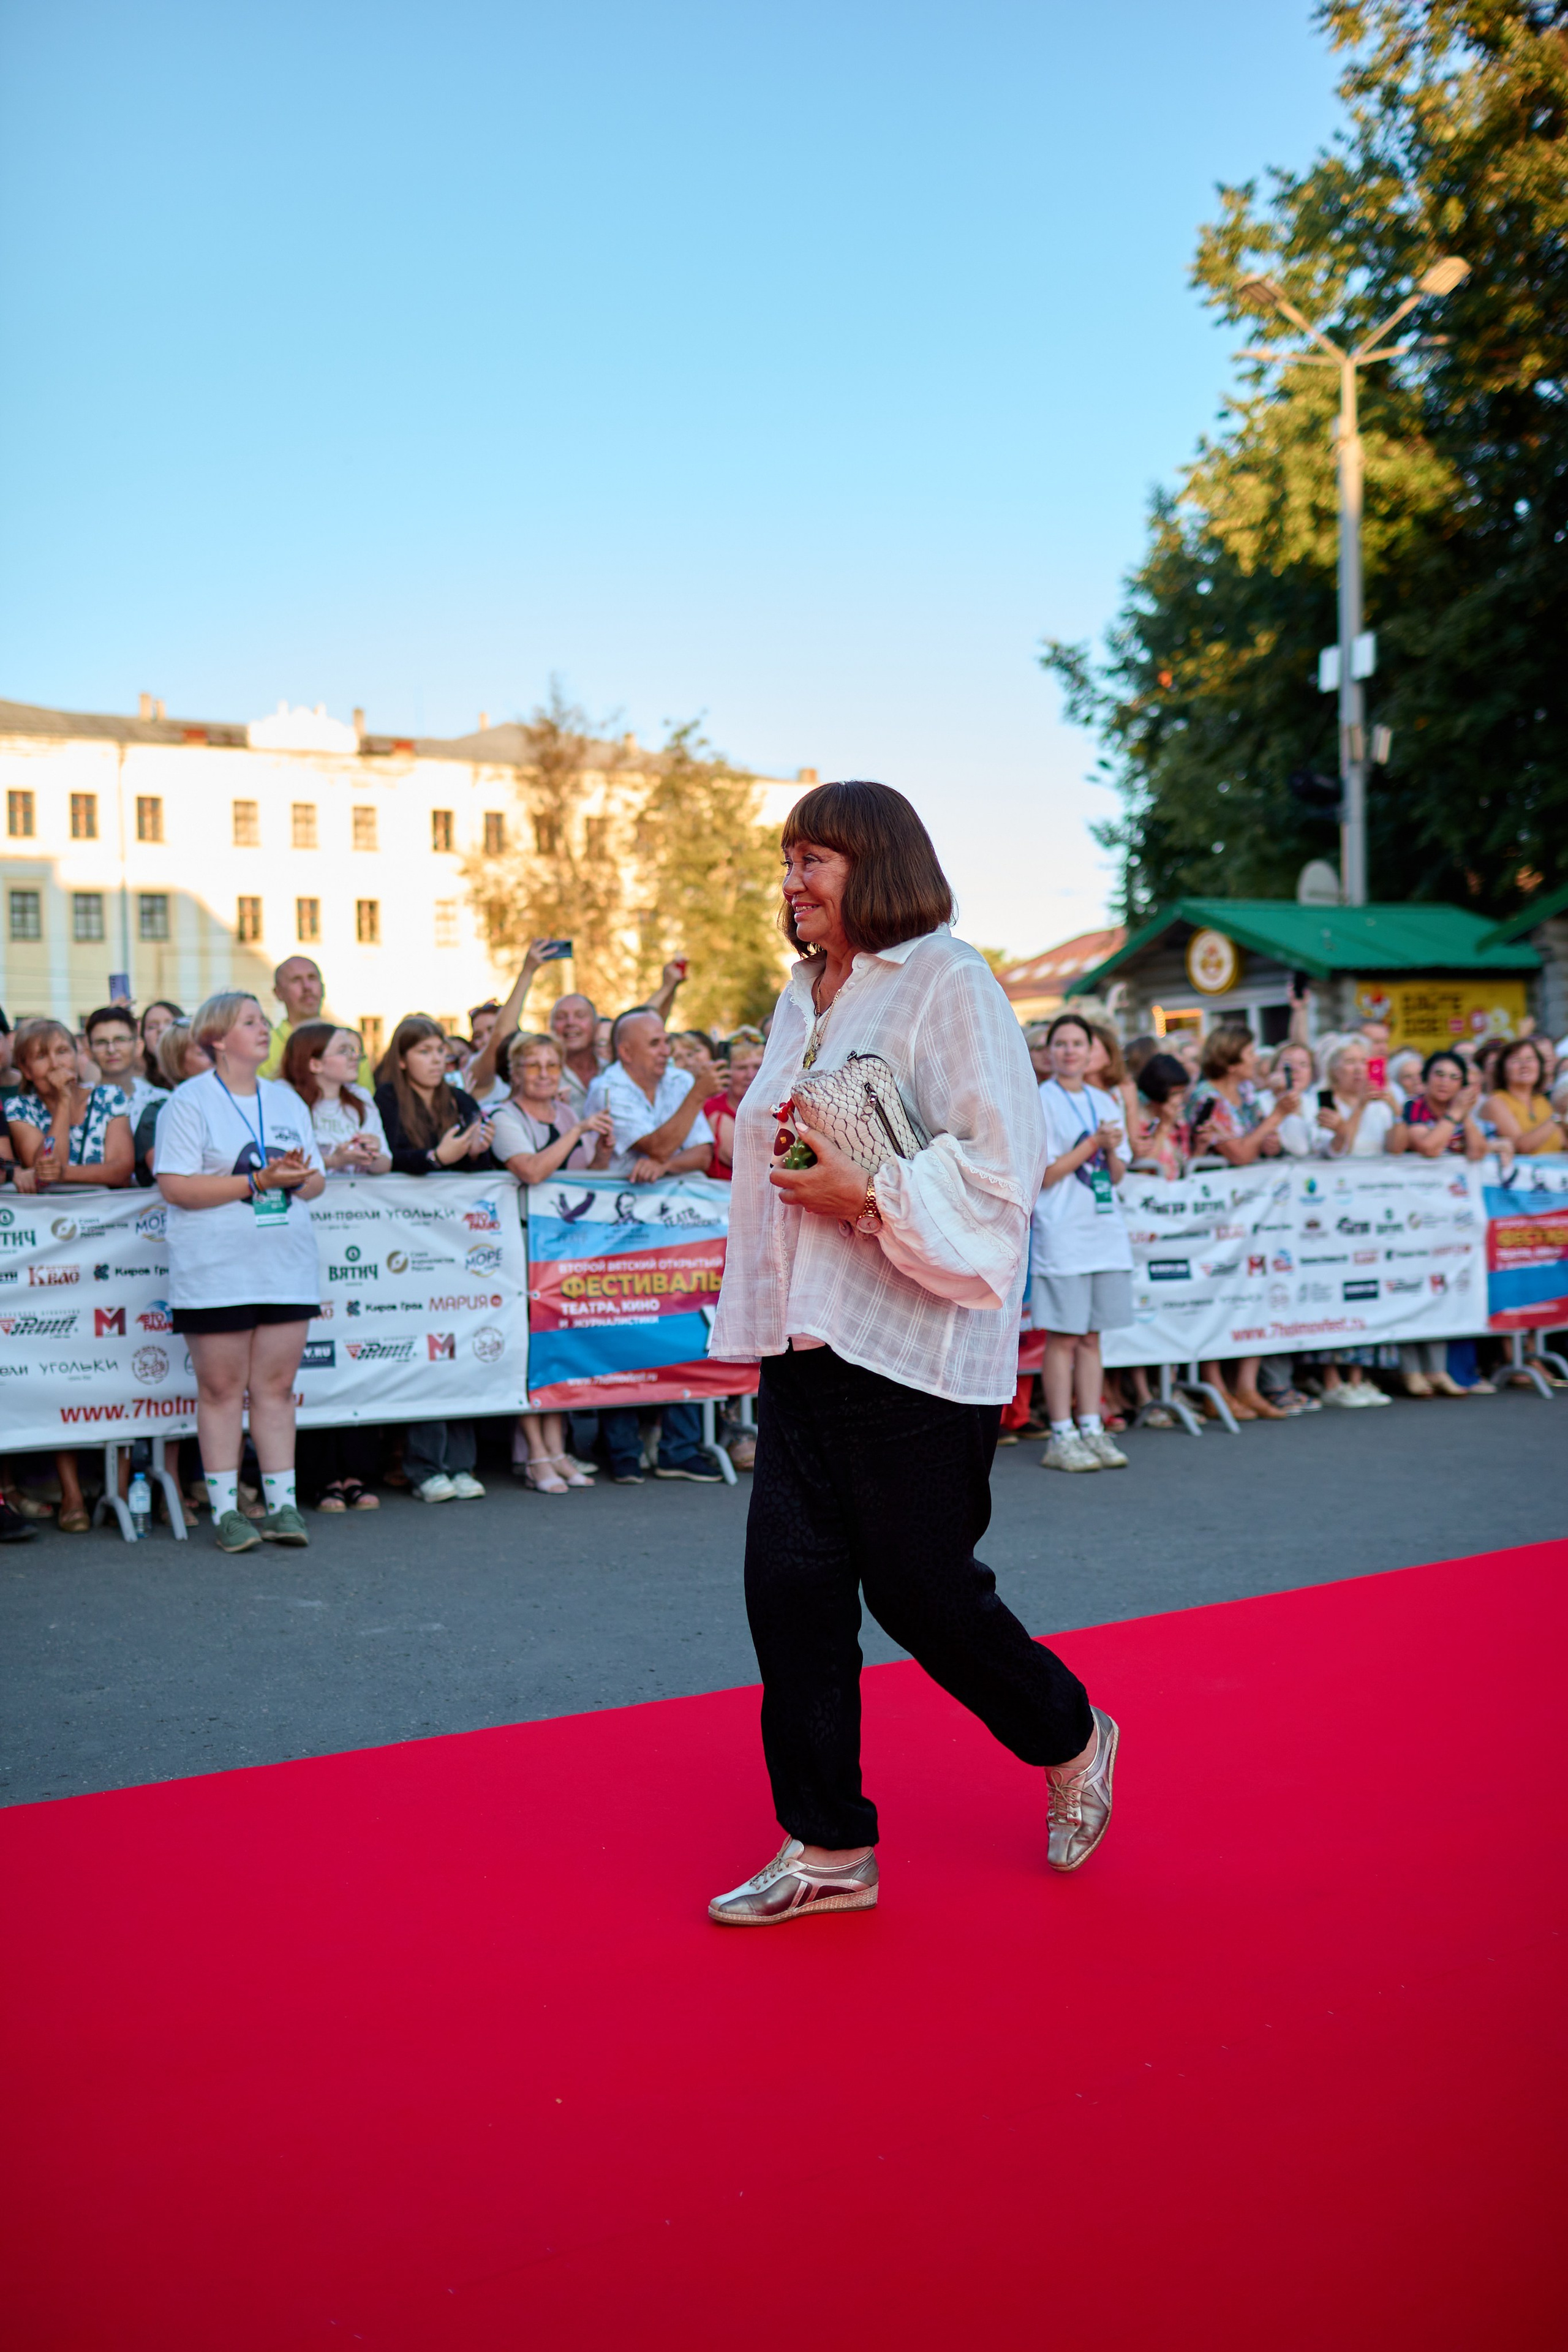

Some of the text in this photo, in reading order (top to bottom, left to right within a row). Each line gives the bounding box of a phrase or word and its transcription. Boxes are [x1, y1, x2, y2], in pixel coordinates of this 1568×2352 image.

[135, 1215, 167, 1234] МОР
[0, 1230, 37, 1247] ТИЧ
[465, 1247, 503, 1270] МОРЕ
[558, 1261, 605, 1274] ВТОРОЙ
[607, 1259, 657, 1272] ВЯТСКИЙ
[116, 1267, 150, 1278] Киров
[154, 1265, 169, 1277] Гр
[328, 1264, 378, 1282] ВЯТИЧ
[561, 1272, 723, 1299] ФЕСТИВАЛЬ
[366, 1304, 397, 1314] Киров
[401, 1302, 423, 1313] Град
[560, 1298, 660, 1315] ТЕАТРА, КИНО
[143, 1321, 173, 1332] РАДИ
[303, 1346, 331, 1358] V.RU
[60, 1396, 198, 1424] www.7holm
